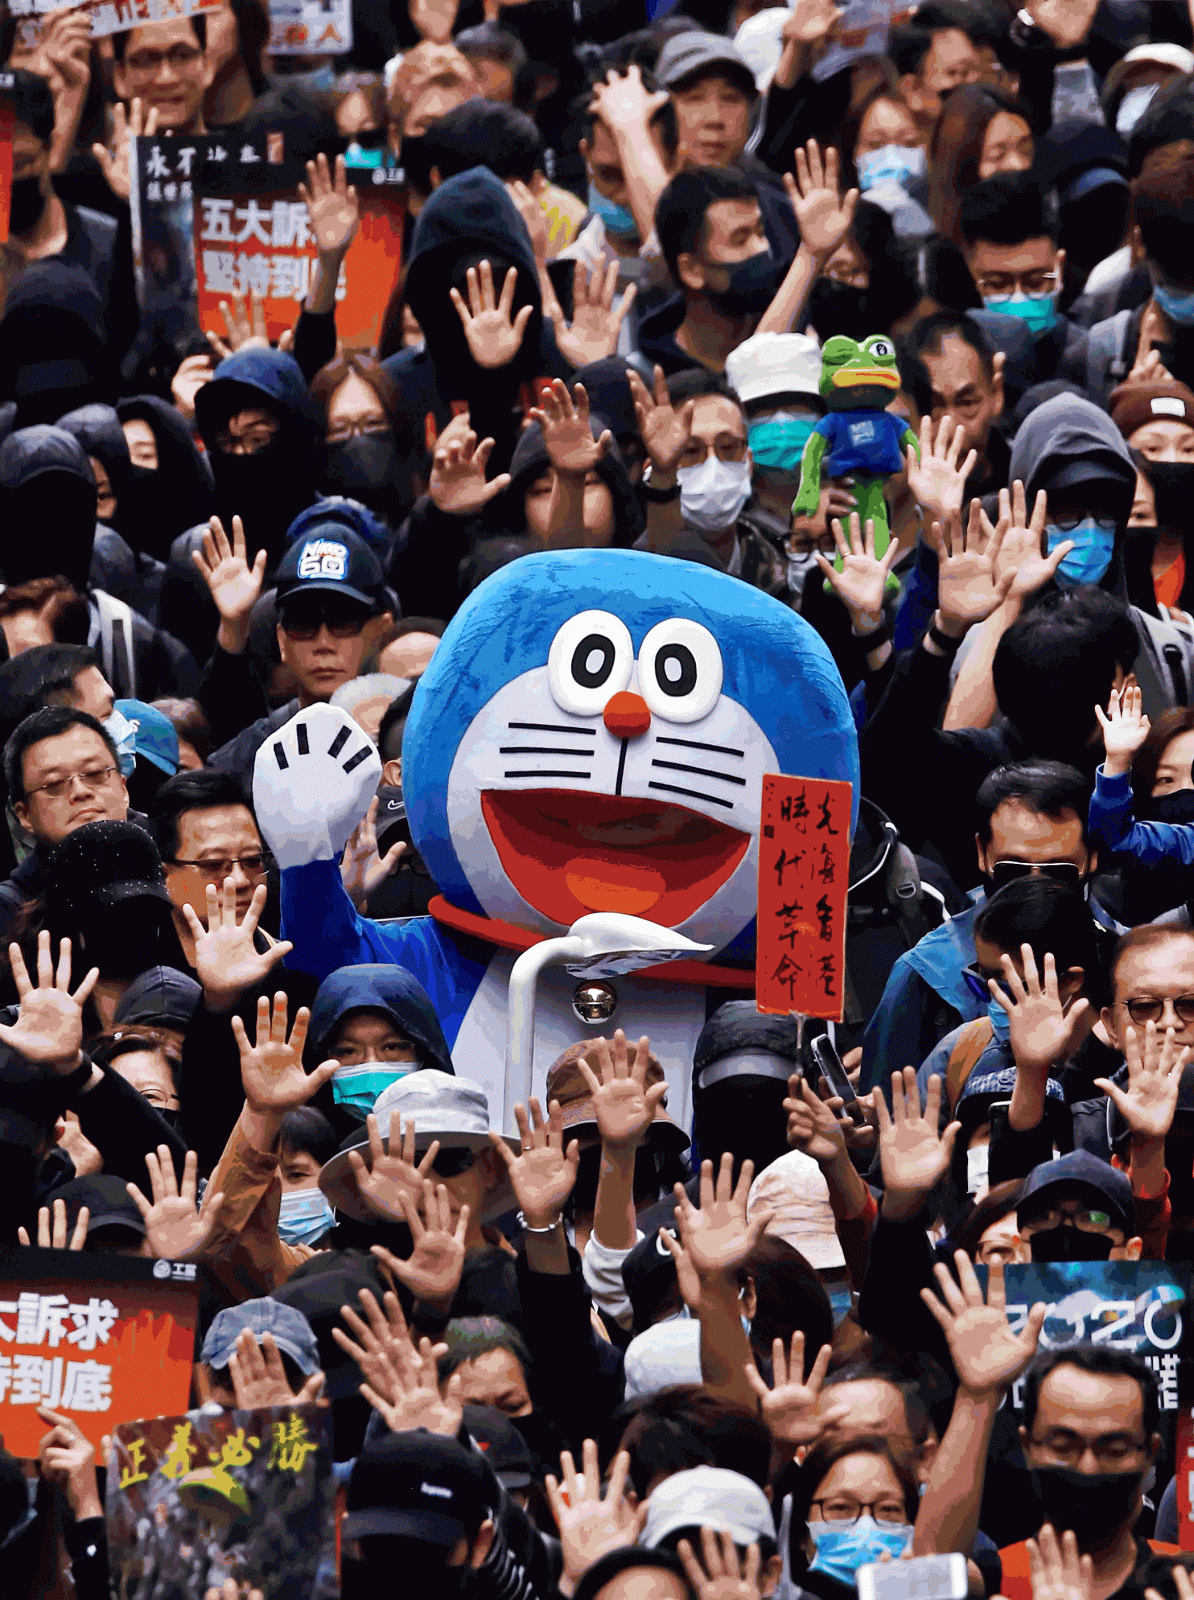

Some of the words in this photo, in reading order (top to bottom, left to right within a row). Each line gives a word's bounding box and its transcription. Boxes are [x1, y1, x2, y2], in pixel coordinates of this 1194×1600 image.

[201, 197, 318, 249] 五大訴
[203, 250, 347, 301] 堅持到
[771, 785, 811, 1001] 時代革命
[119, 1412, 319, 1490] 正義必勝
